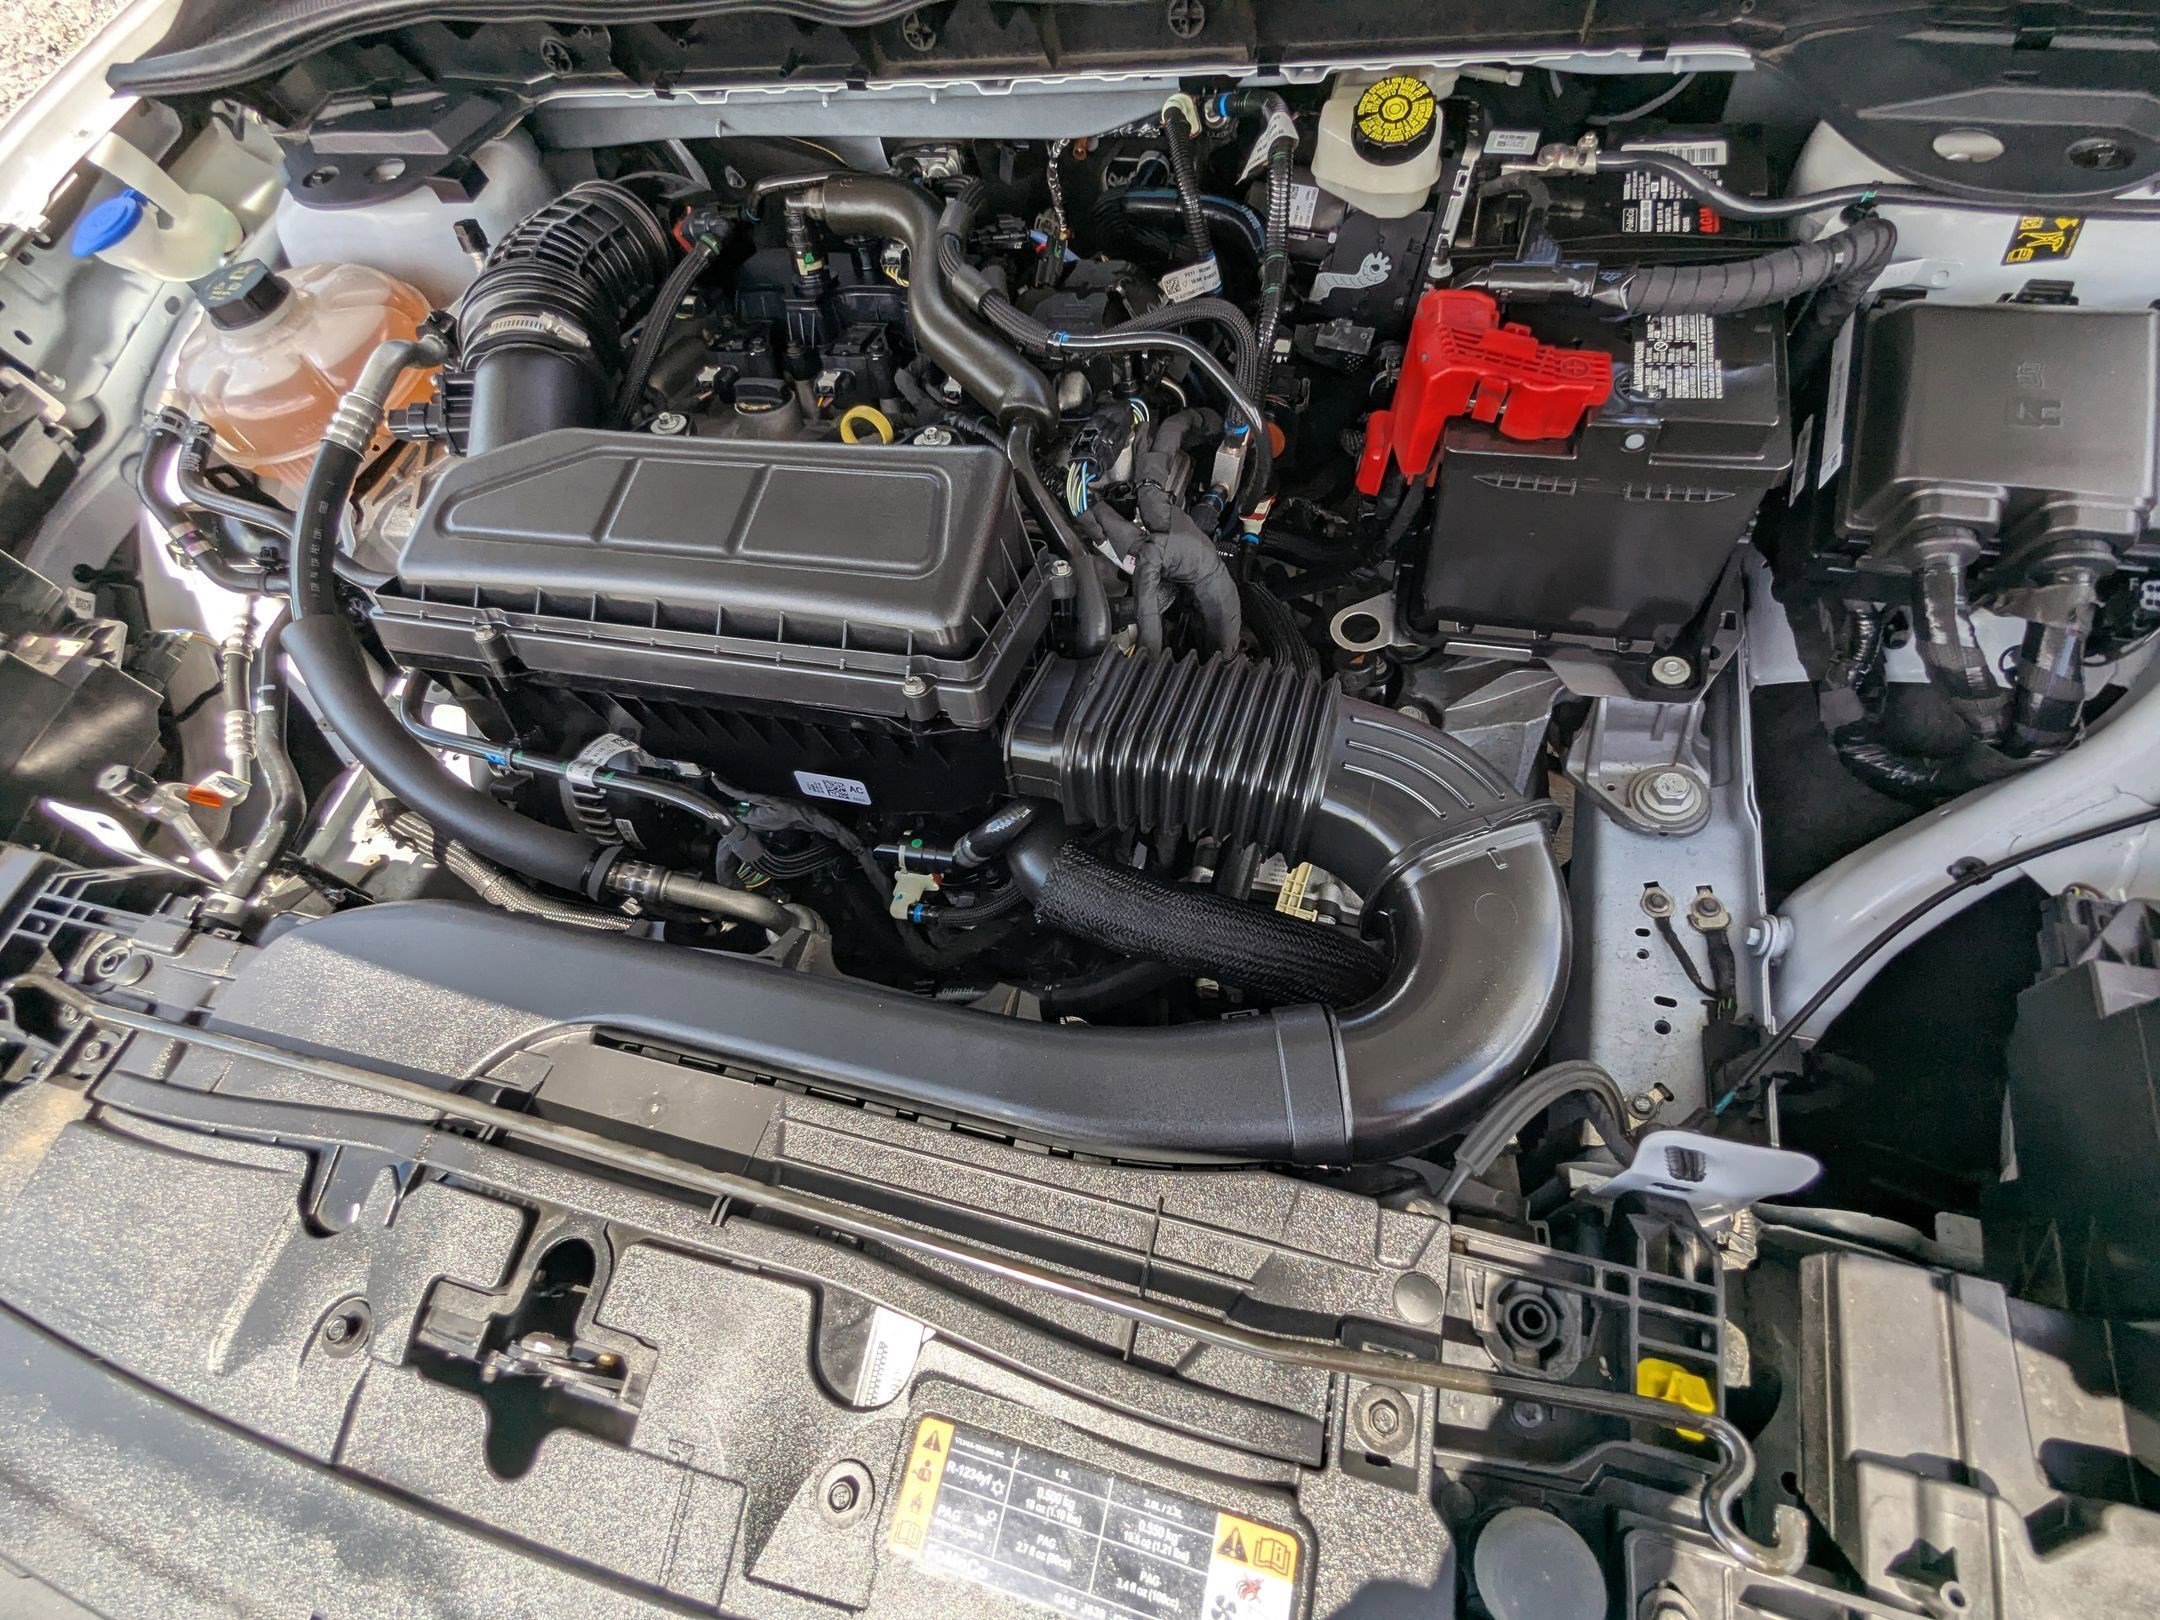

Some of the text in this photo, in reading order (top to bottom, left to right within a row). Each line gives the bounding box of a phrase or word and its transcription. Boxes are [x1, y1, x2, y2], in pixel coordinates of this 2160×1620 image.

[1700, 207, 1714, 233] AGM
[850, 785, 864, 795] AC
[1036, 1503, 1046, 1514] oz
[1062, 1493, 1077, 1512] kg
[935, 1503, 962, 1524] PAG
[1036, 1533, 1057, 1551] PAG
[1139, 1537, 1151, 1548] oz
[1163, 1527, 1180, 1547] kg
[1036, 1550, 1046, 1561] oz
[1139, 1570, 1159, 1587] PAG
[1137, 1584, 1148, 1597] oz
[1053, 1592, 1077, 1611] SAE
